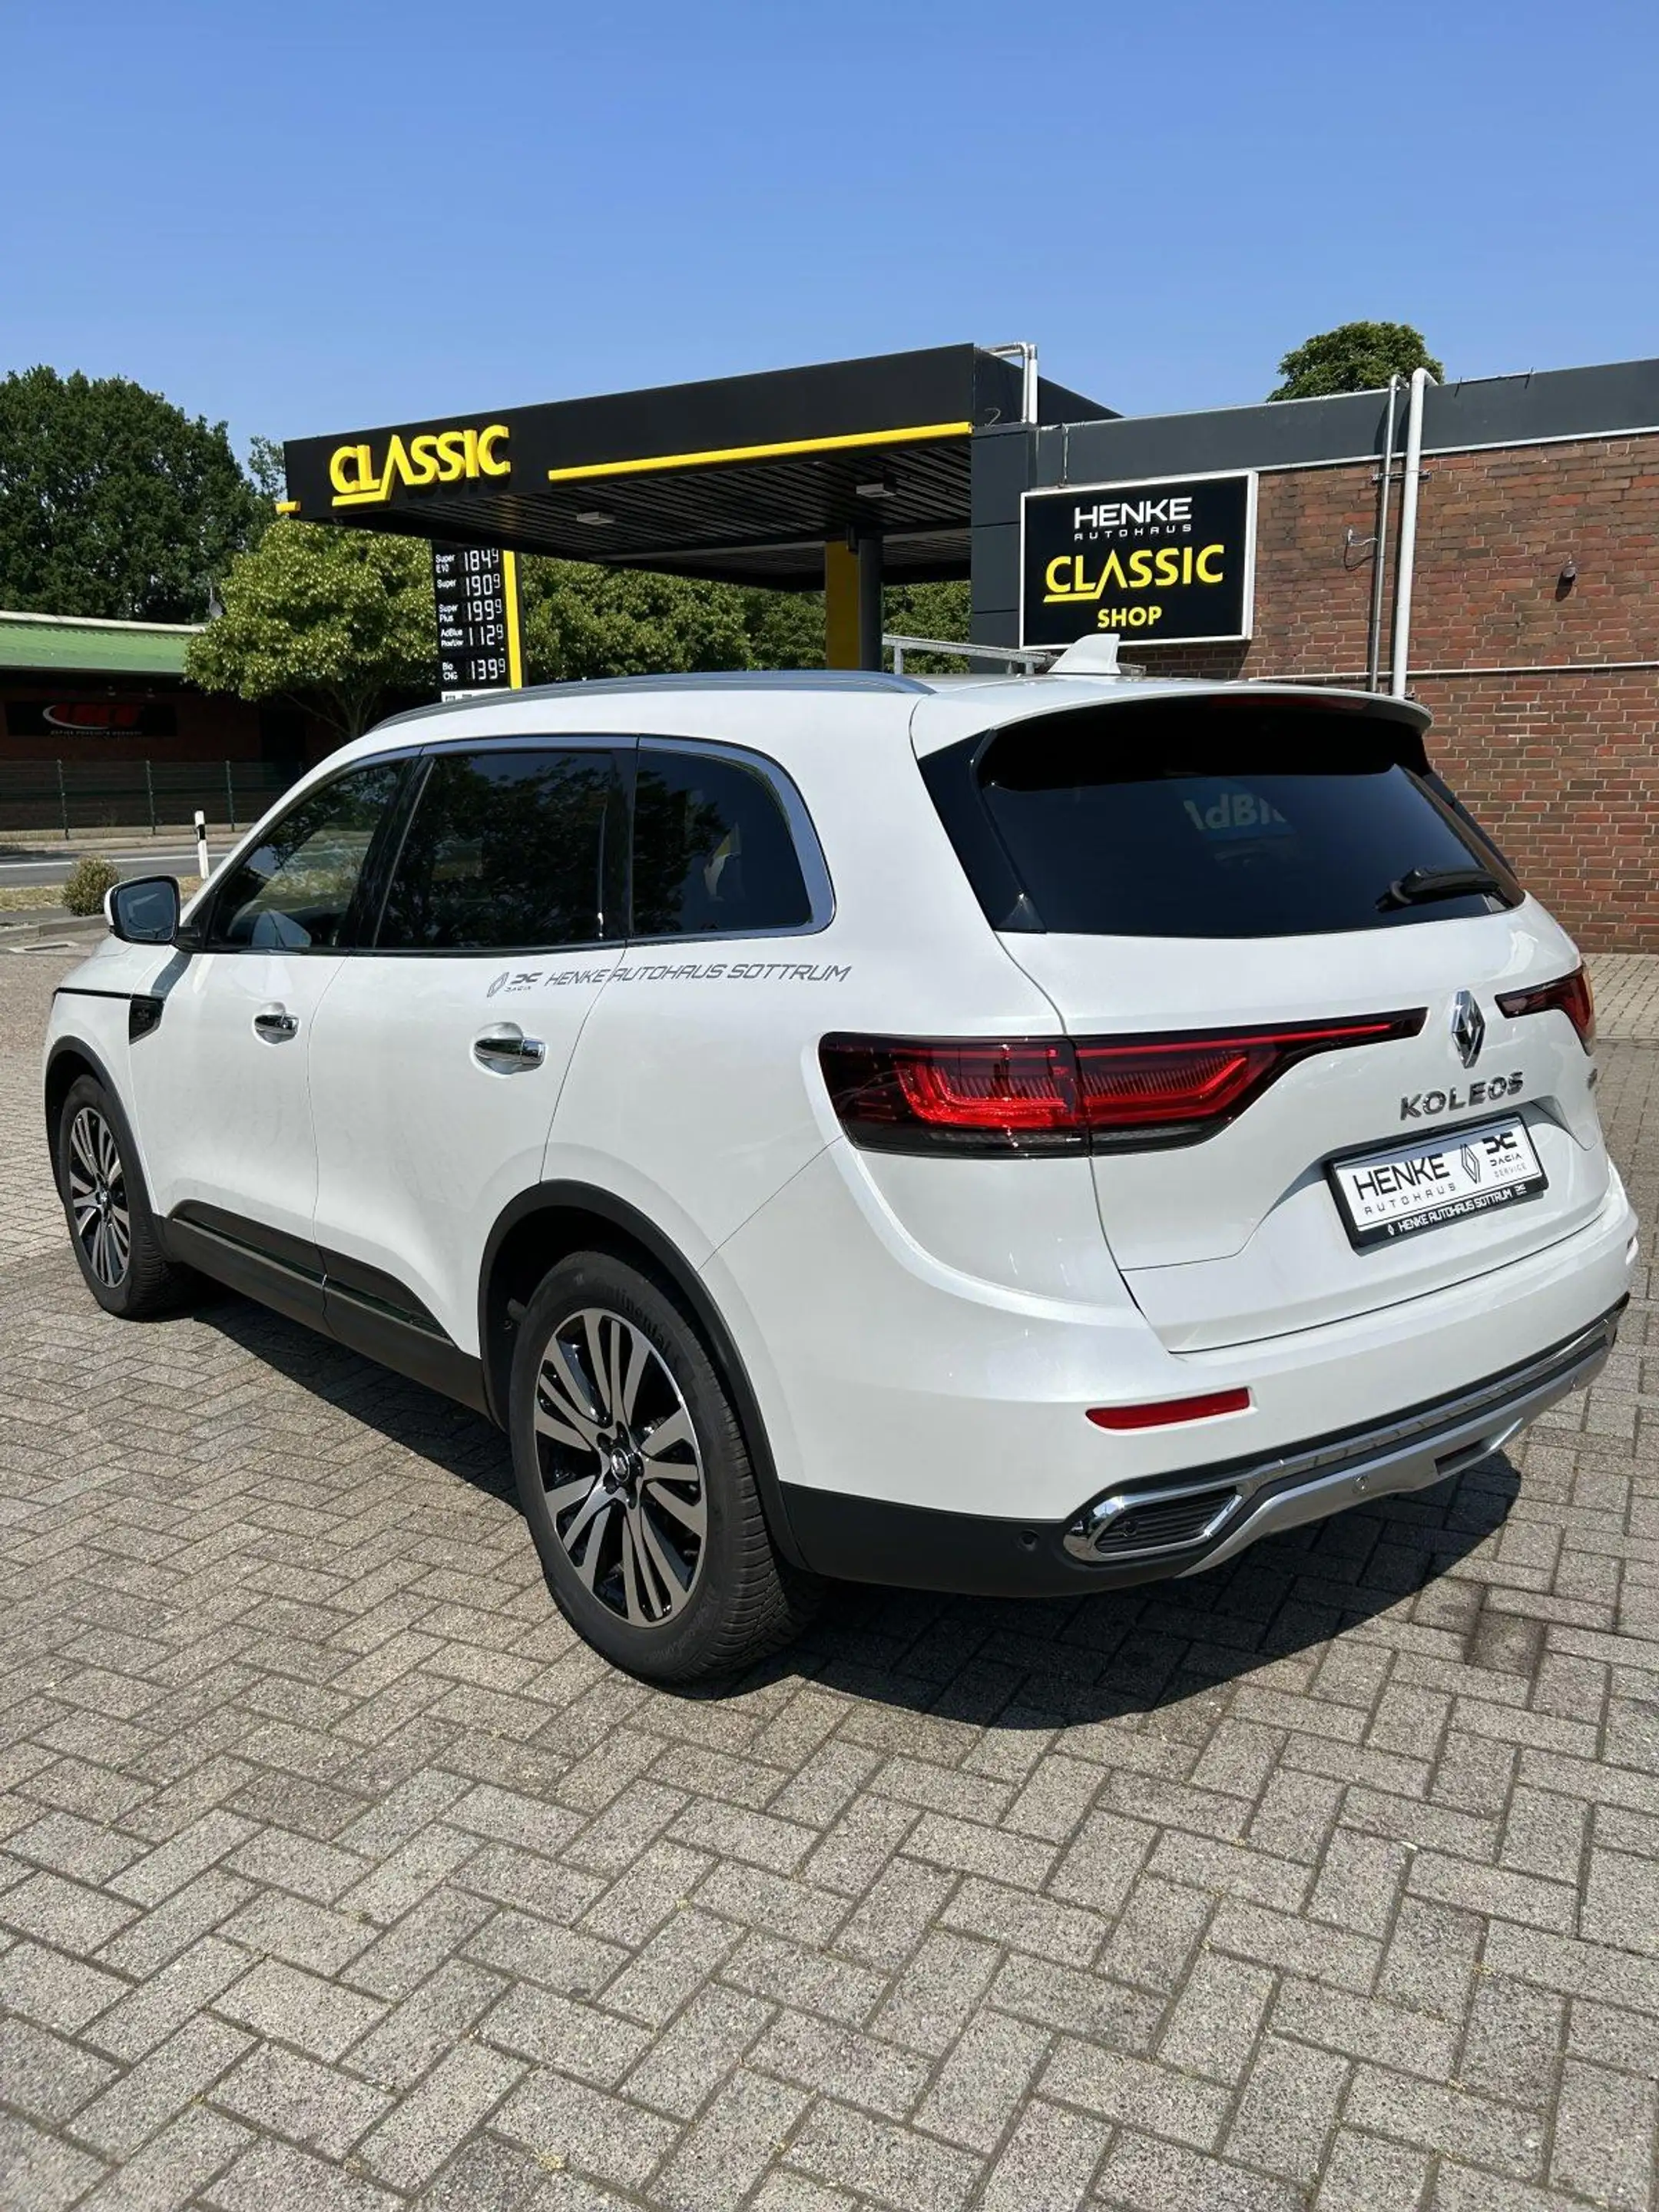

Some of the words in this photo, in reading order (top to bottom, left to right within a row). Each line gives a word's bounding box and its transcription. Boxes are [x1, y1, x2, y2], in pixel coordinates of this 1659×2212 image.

[330, 425, 512, 507] CLASSIC
[1075, 497, 1193, 529] HENKE
[1075, 524, 1193, 541] AUTOHAUS
[435, 555, 455, 565] Super
[435, 564, 449, 574] E10
[436, 579, 457, 589] Super
[1043, 544, 1224, 602] CLASSIC
[465, 573, 501, 597] 1909
[439, 604, 459, 614] Super
[439, 614, 455, 623] Plus
[467, 598, 502, 621] 1999
[1098, 605, 1162, 628] SHOP
[441, 628, 463, 637] AdBlue
[469, 624, 504, 646] 1129
[443, 671, 459, 681] CNG
[471, 658, 506, 680] 1399
[544, 969, 611, 987] HENKE
[608, 964, 728, 982] AUTOHAUS
[727, 964, 853, 982] SOTTRUM
[1400, 1071, 1524, 1121] KOLEOS
[1489, 1153, 1523, 1167] DACIA
[1353, 1153, 1450, 1200] HENKE
[1364, 1183, 1457, 1215] AUTOHAUS
[1398, 1214, 1430, 1232] HENKE
[1429, 1202, 1475, 1224] AUTOHAUS
[1475, 1189, 1513, 1209] SOTTRUM
